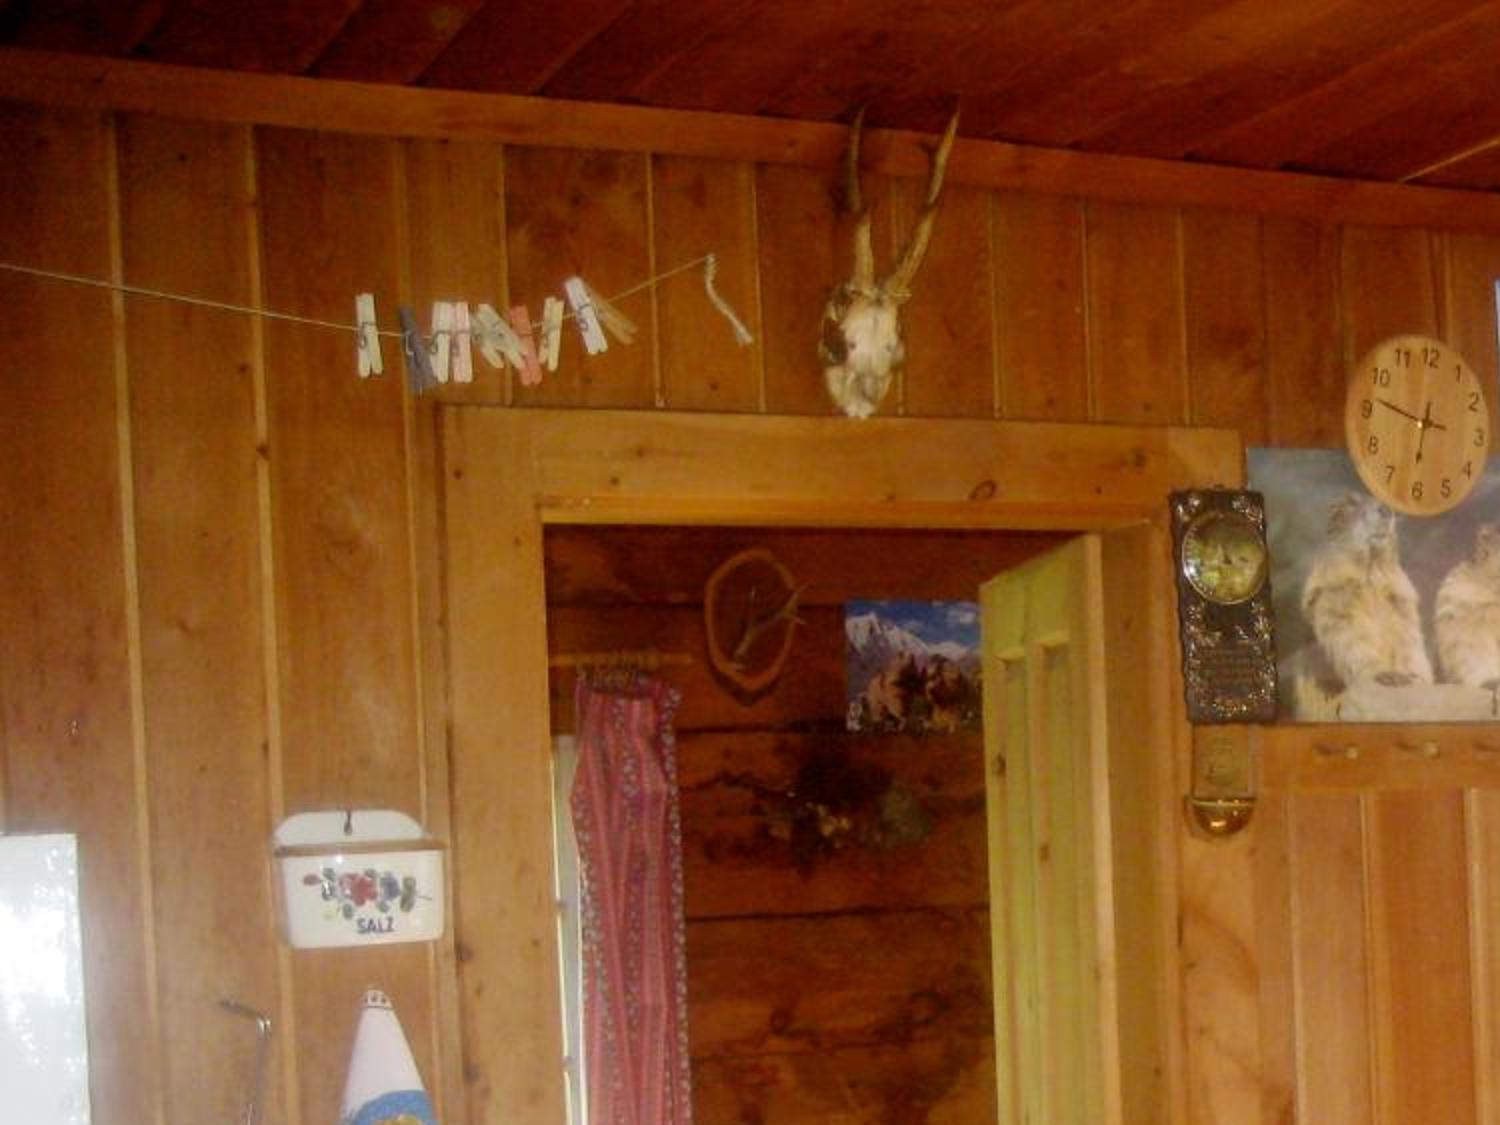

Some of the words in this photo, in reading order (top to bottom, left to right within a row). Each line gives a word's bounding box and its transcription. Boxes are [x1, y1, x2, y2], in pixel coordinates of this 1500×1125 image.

[1395, 348, 1411, 368] 11
[1422, 347, 1440, 368] 12
[1371, 366, 1391, 387] 10
[1455, 363, 1462, 383] 1
[1361, 399, 1373, 419] 9
[1468, 392, 1479, 412] 2
[1368, 435, 1379, 455] 8
[1473, 428, 1485, 447] 3
[1384, 465, 1396, 485] 7
[1461, 460, 1472, 480] 4
[1411, 481, 1423, 501] 6
[1440, 479, 1452, 498] 5
[356, 916, 395, 934] SALZ
